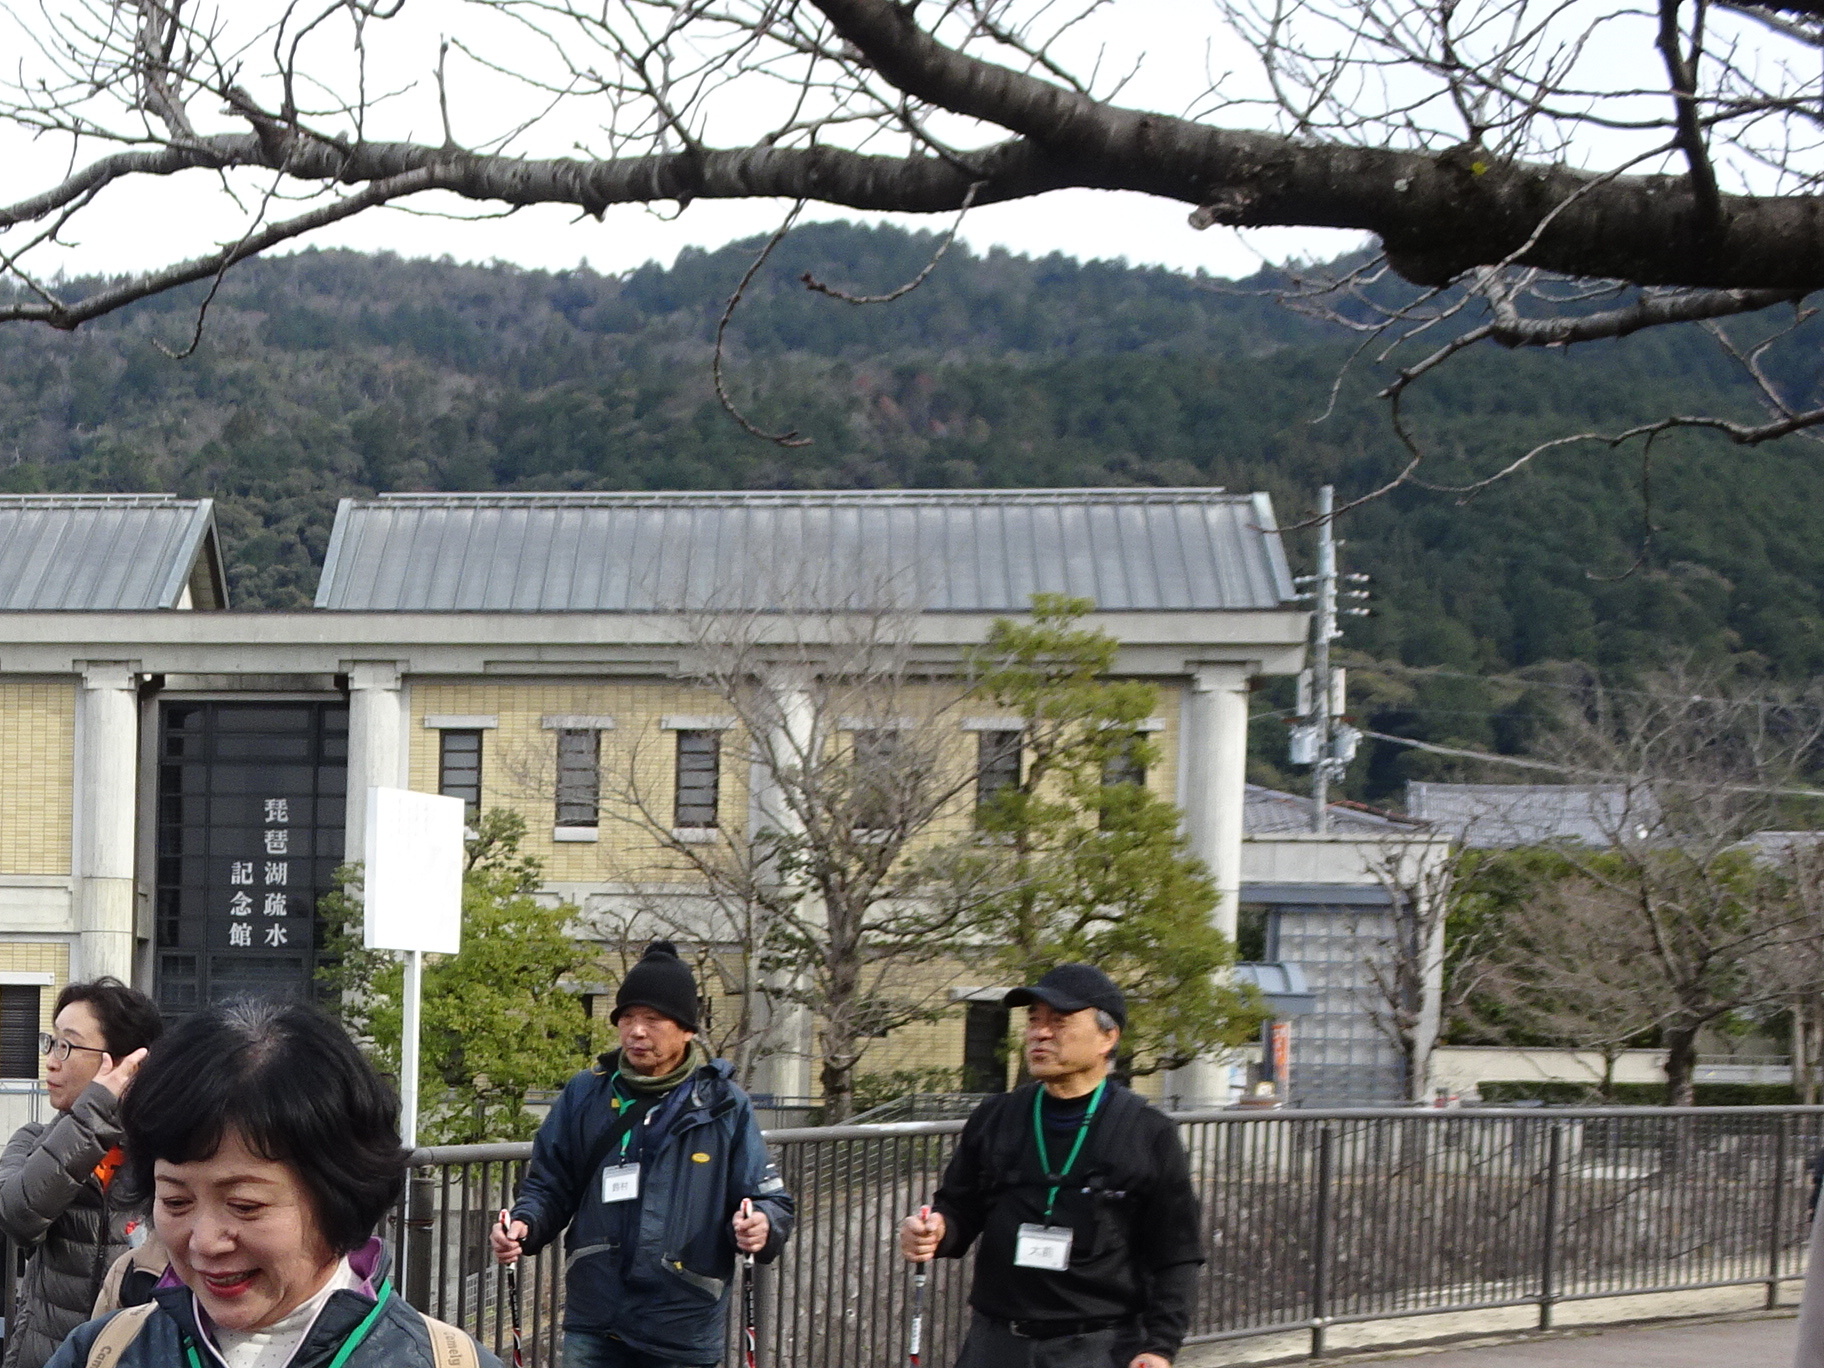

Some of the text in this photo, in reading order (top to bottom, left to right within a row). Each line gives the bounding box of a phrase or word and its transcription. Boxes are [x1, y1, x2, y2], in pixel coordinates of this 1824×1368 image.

[229, 861, 254, 947] 記念館
[263, 798, 289, 947] 琵琶湖疏水
